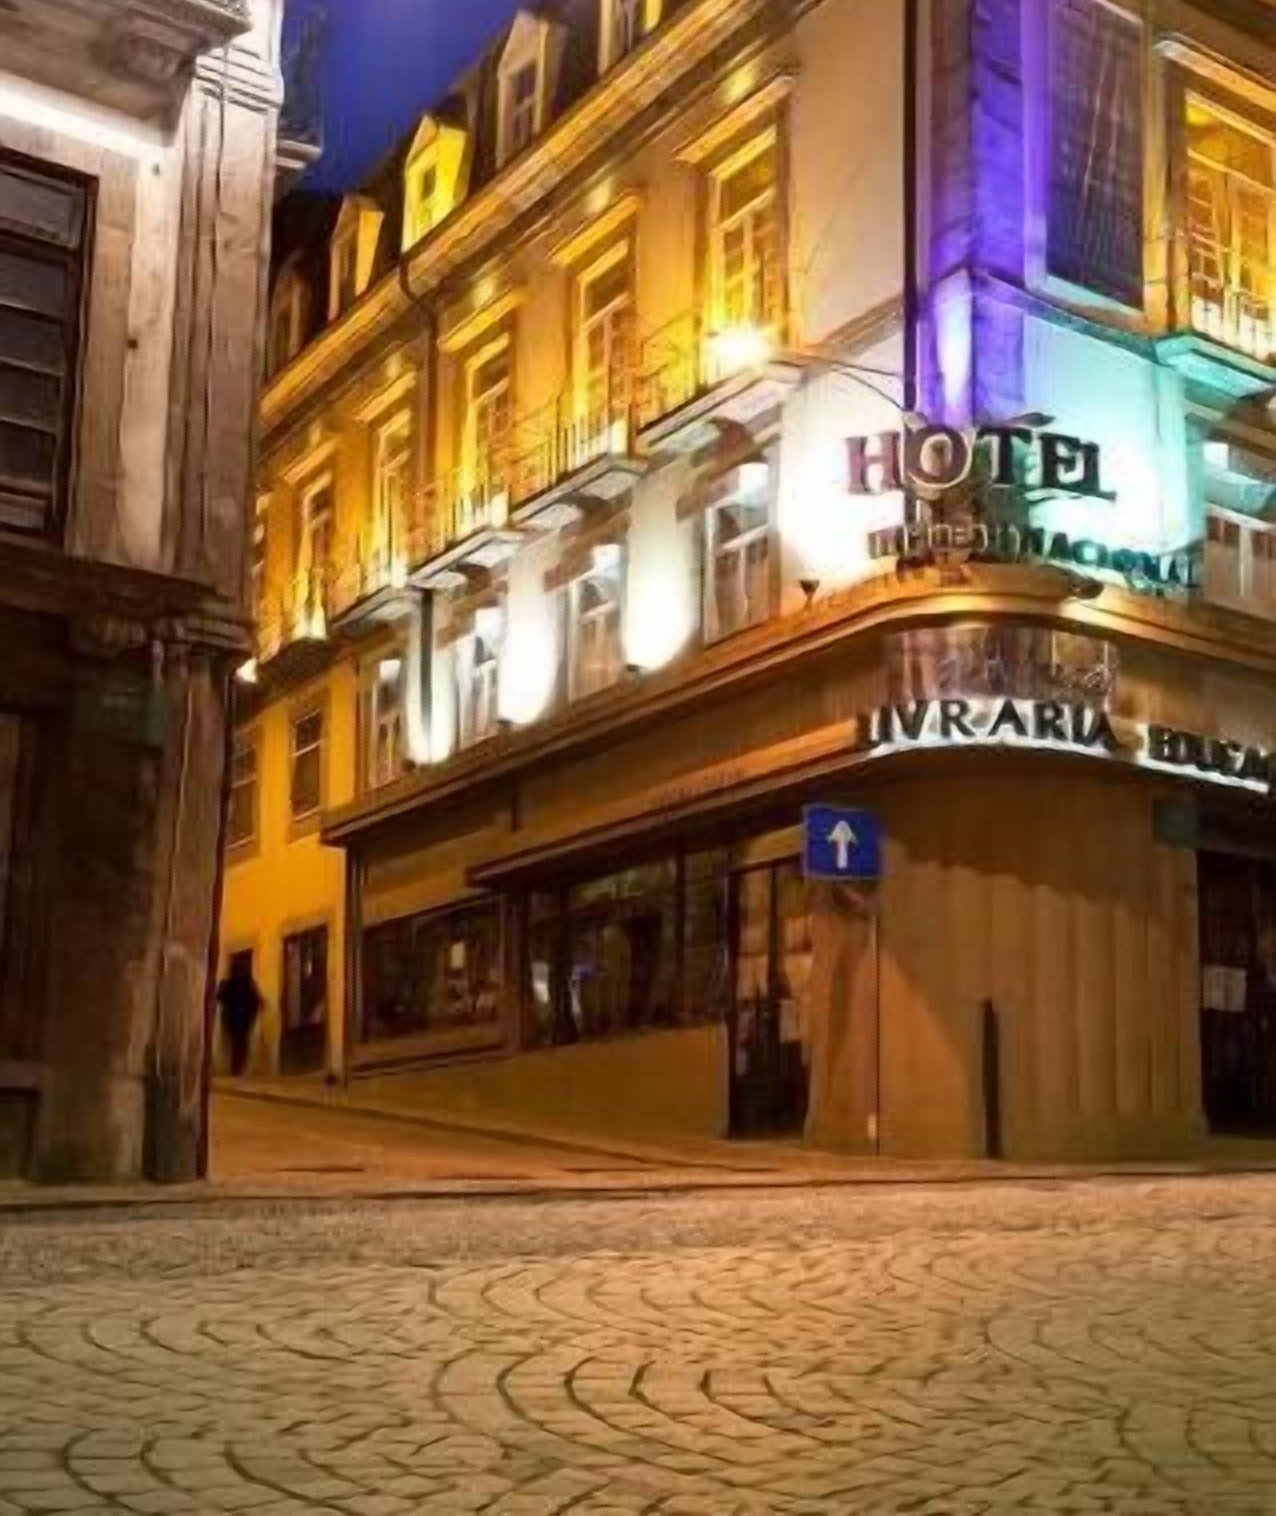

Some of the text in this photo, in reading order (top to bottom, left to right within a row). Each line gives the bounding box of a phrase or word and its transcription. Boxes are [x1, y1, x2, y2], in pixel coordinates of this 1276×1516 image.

[846, 424, 1117, 501] HOTEL
[857, 698, 1276, 784] LIVRARIA EDUCA
